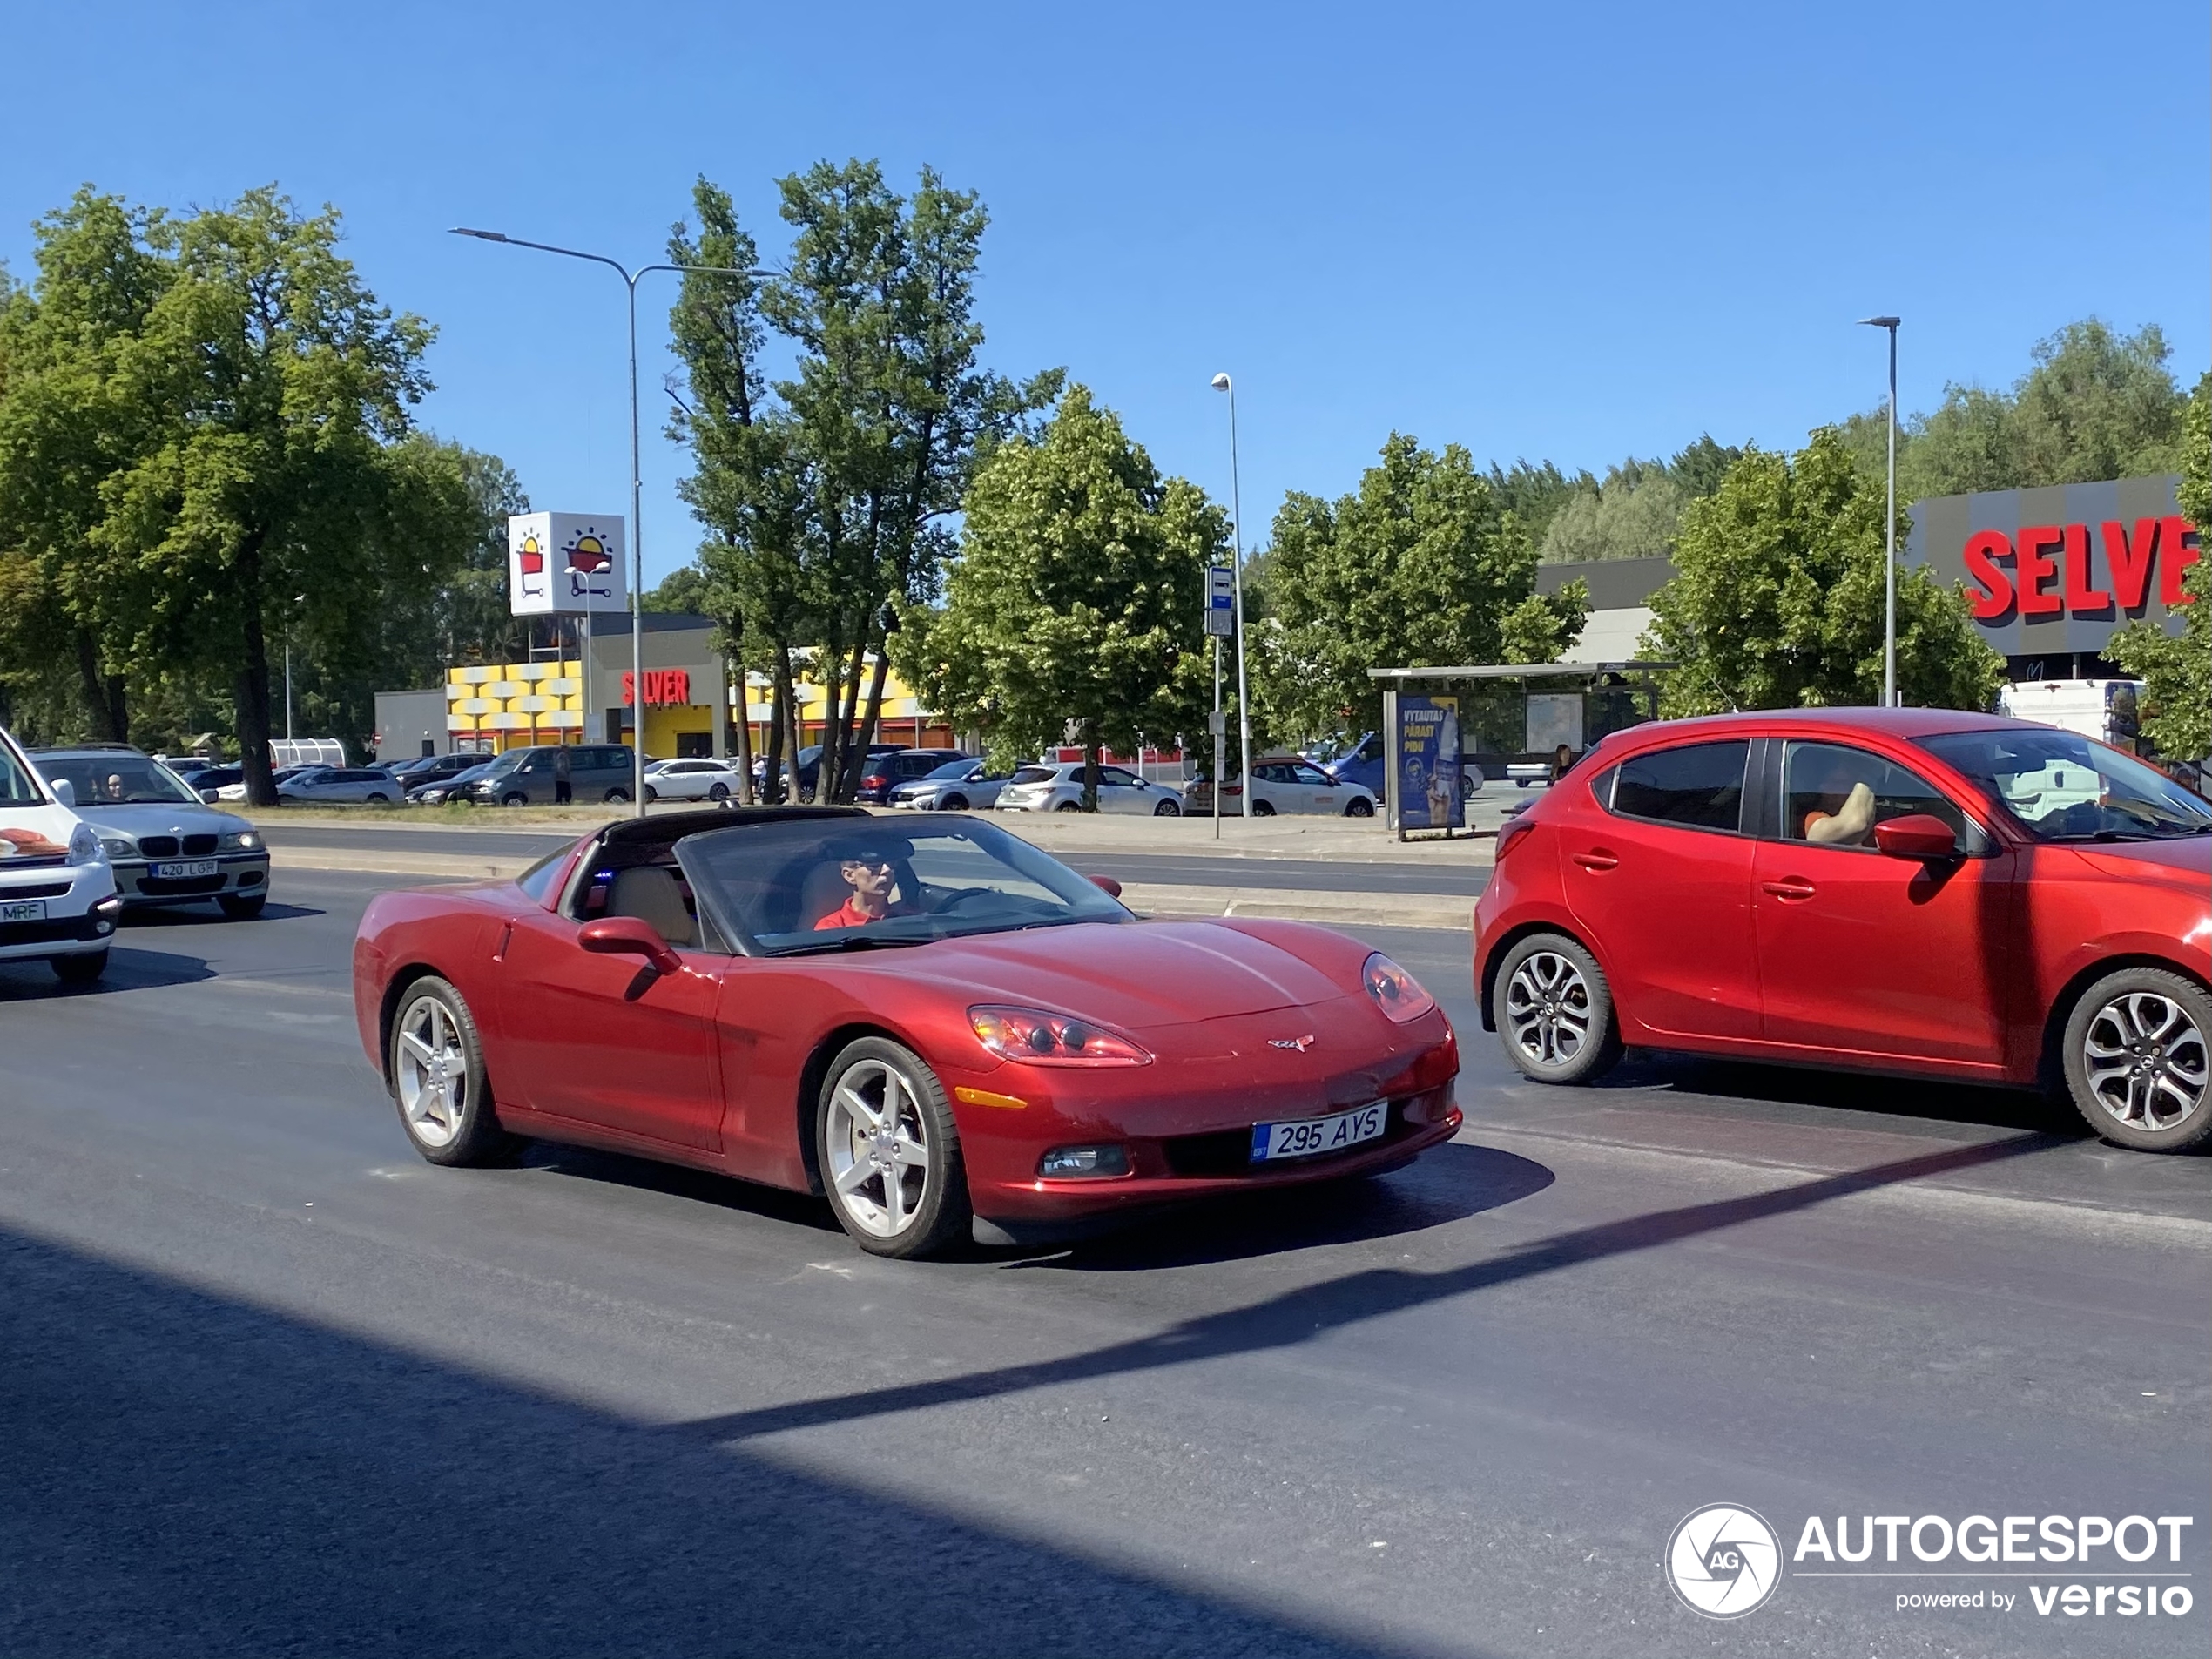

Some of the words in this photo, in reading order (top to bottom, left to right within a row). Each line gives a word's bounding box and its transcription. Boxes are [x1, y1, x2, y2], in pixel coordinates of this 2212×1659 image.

[621, 668, 689, 705] SLVER
[1404, 710, 1444, 722] VYTAUTAS
[1404, 722, 1435, 738] PÄRAST
[1404, 741, 1425, 753] PIDU
[161, 865, 184, 876] 420
[189, 861, 215, 875] LGR
[3, 904, 39, 921] MRF
[1277, 1123, 1325, 1154] 295
[1330, 1108, 1379, 1146] AYS
